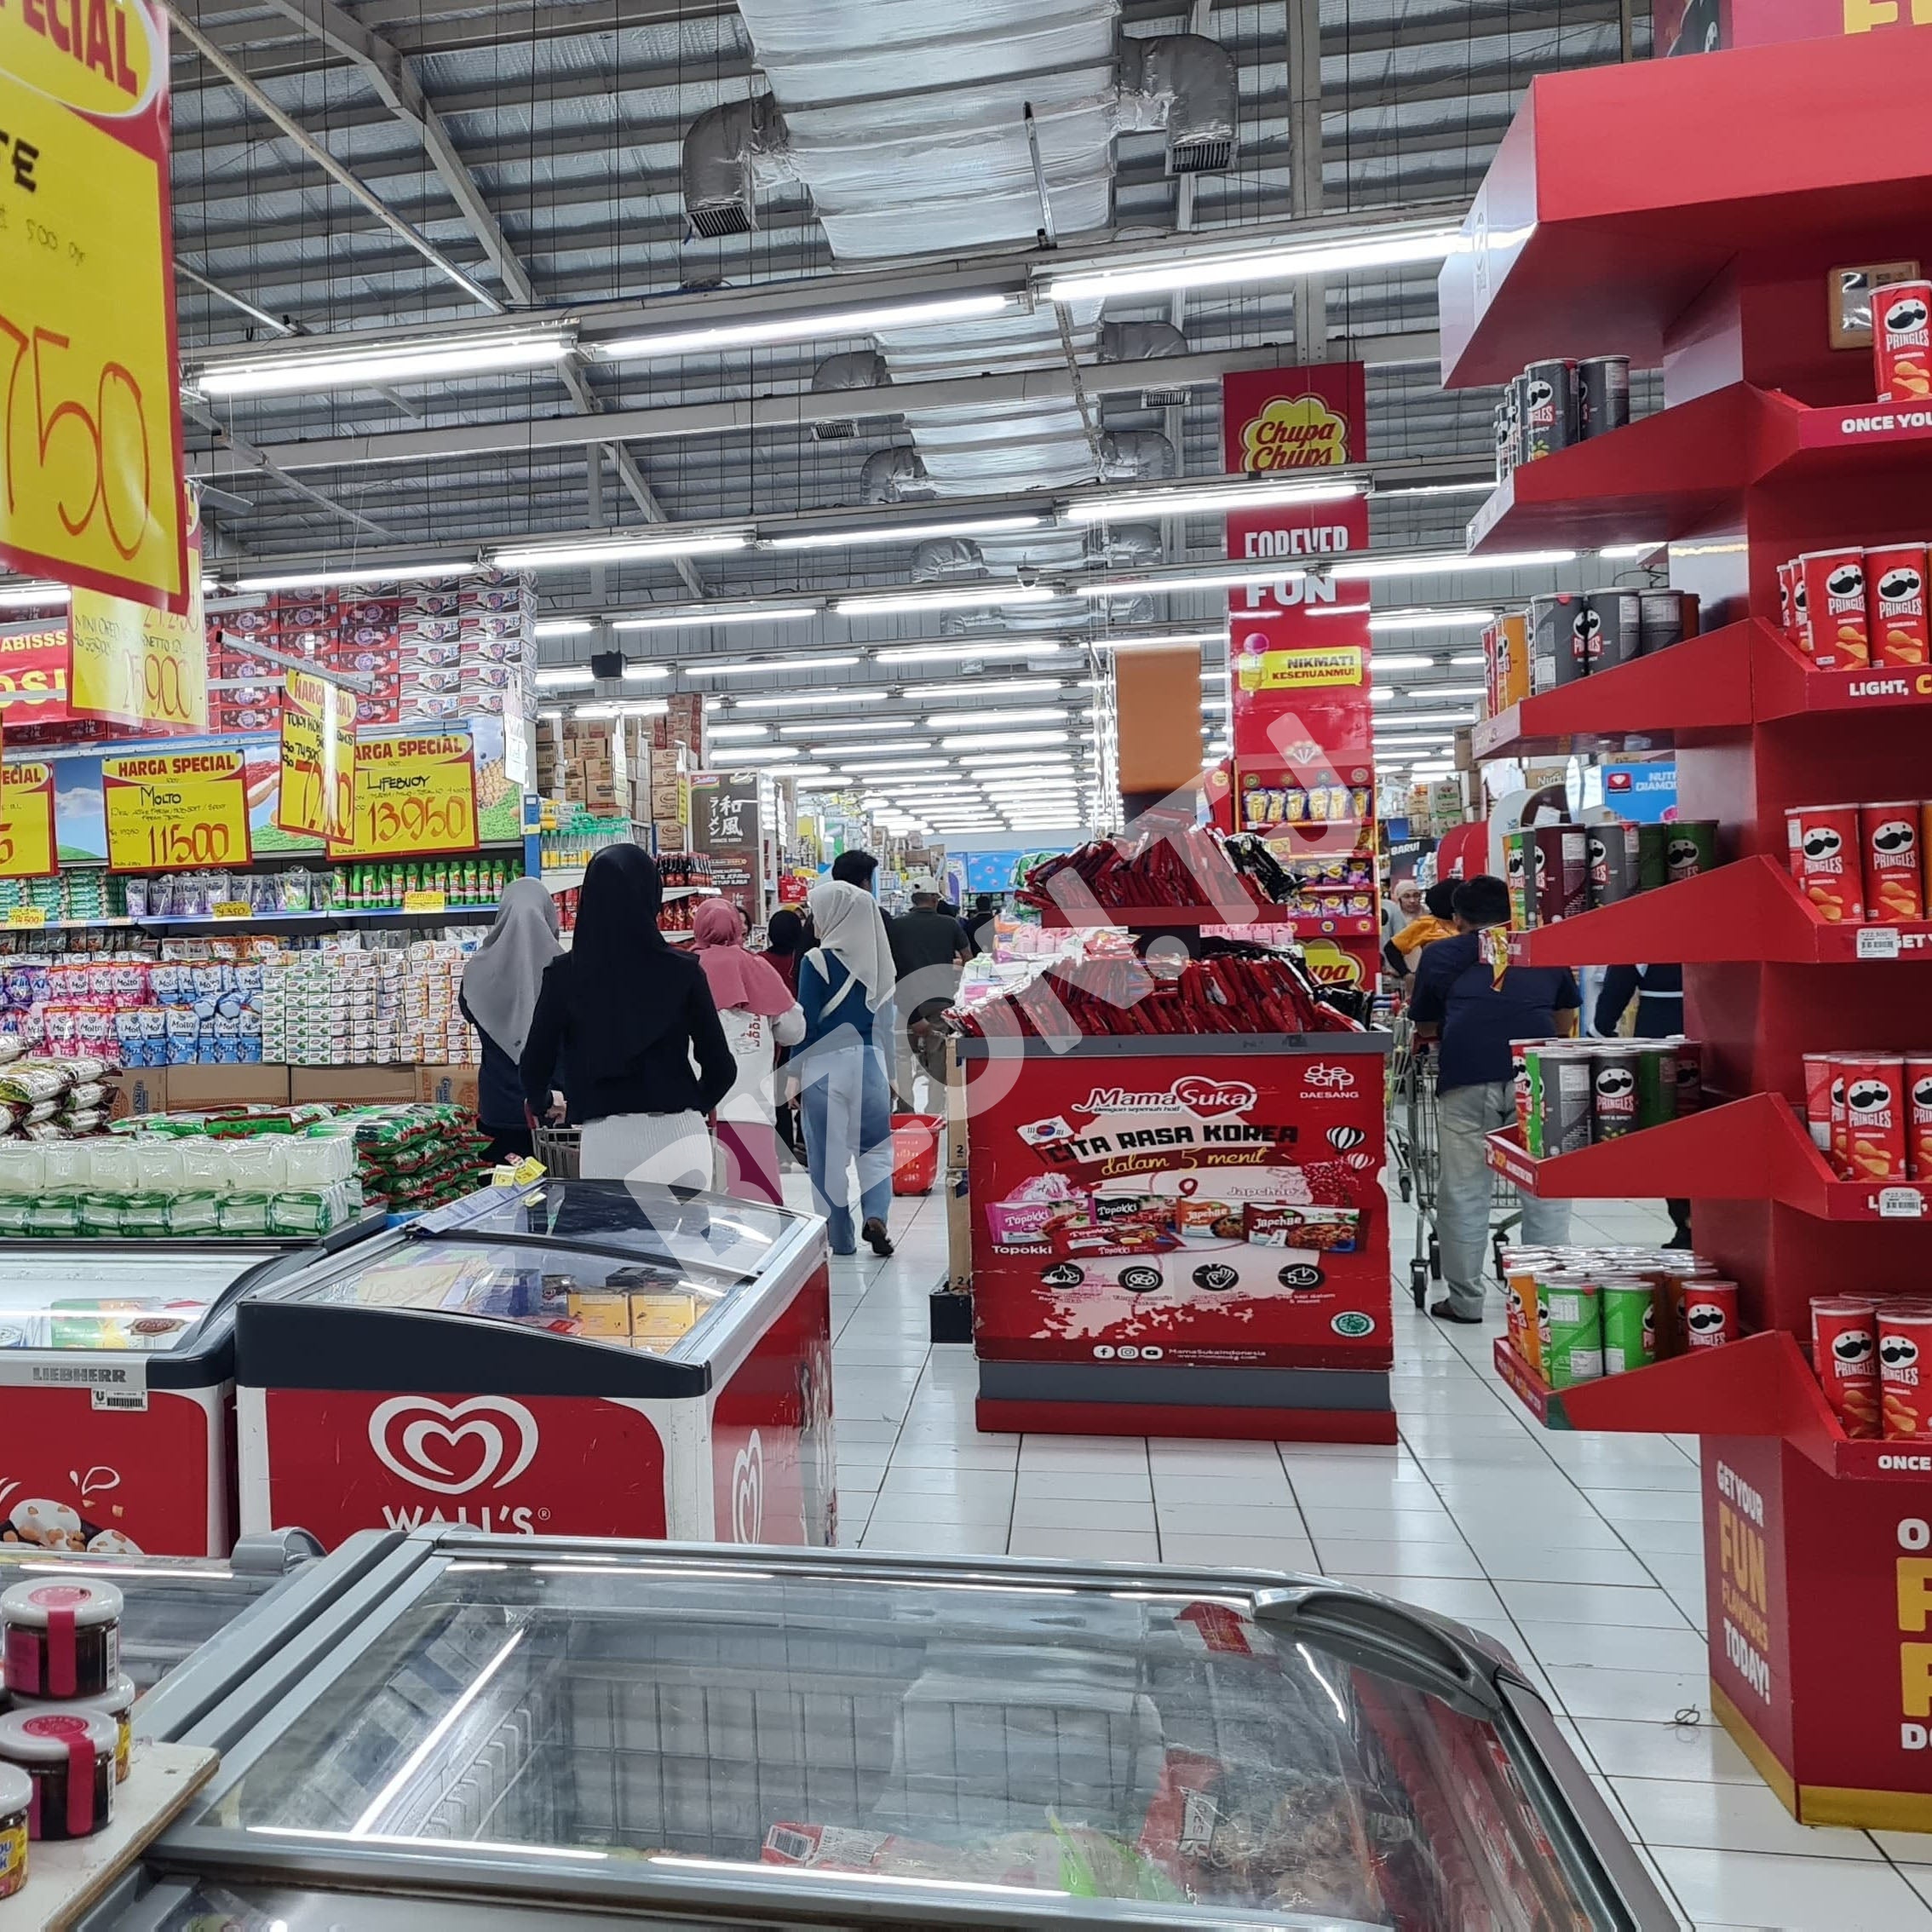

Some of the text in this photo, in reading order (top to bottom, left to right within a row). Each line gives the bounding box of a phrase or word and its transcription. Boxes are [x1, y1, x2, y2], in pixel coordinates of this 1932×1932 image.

[0, 0, 138, 97] ECIAL
[1885, 329, 1929, 352] PRINGLES
[1842, 415, 1895, 433] ONCE
[1256, 421, 1336, 450] Chupa
[1245, 575, 1337, 607] FUN
[1879, 598, 1923, 620] PRINGLES
[1288, 655, 1354, 669] NIKMATI
[1849, 679, 1909, 697] LIGHT,
[355, 738, 463, 761] ARGA SPECIAL
[118, 755, 235, 777] HARGA SPECIAL
[366, 770, 431, 791] LIFEBUOY
[140, 785, 182, 807] MOLTO
[708, 796, 721, 837] ラーメン
[719, 794, 744, 837] 和風
[147, 822, 230, 866] 11500
[1874, 850, 1916, 871] PRINGLES
[171, 1021, 196, 1030] Molto
[1596, 1094, 1635, 1113] PRINGLES
[1849, 1109, 1892, 1130] PRINGLES
[957, 1144, 964, 1154] 2
[1049, 1124, 1298, 1164] CITA RASA KOREA
[1101, 1147, 1269, 1176] dalam 5 menit
[1004, 1210, 1049, 1227] Topokki
[1097, 1201, 1138, 1216] Topokki
[992, 1245, 1052, 1255] Topokki
[32, 1366, 127, 1383] LIEBHERR
[1878, 1455, 1932, 1471] ONCE
[1716, 1460, 1764, 1527] GET YOUR
[1718, 1500, 1767, 1614] FUN
[1723, 1617, 1771, 1706] TODAY!
